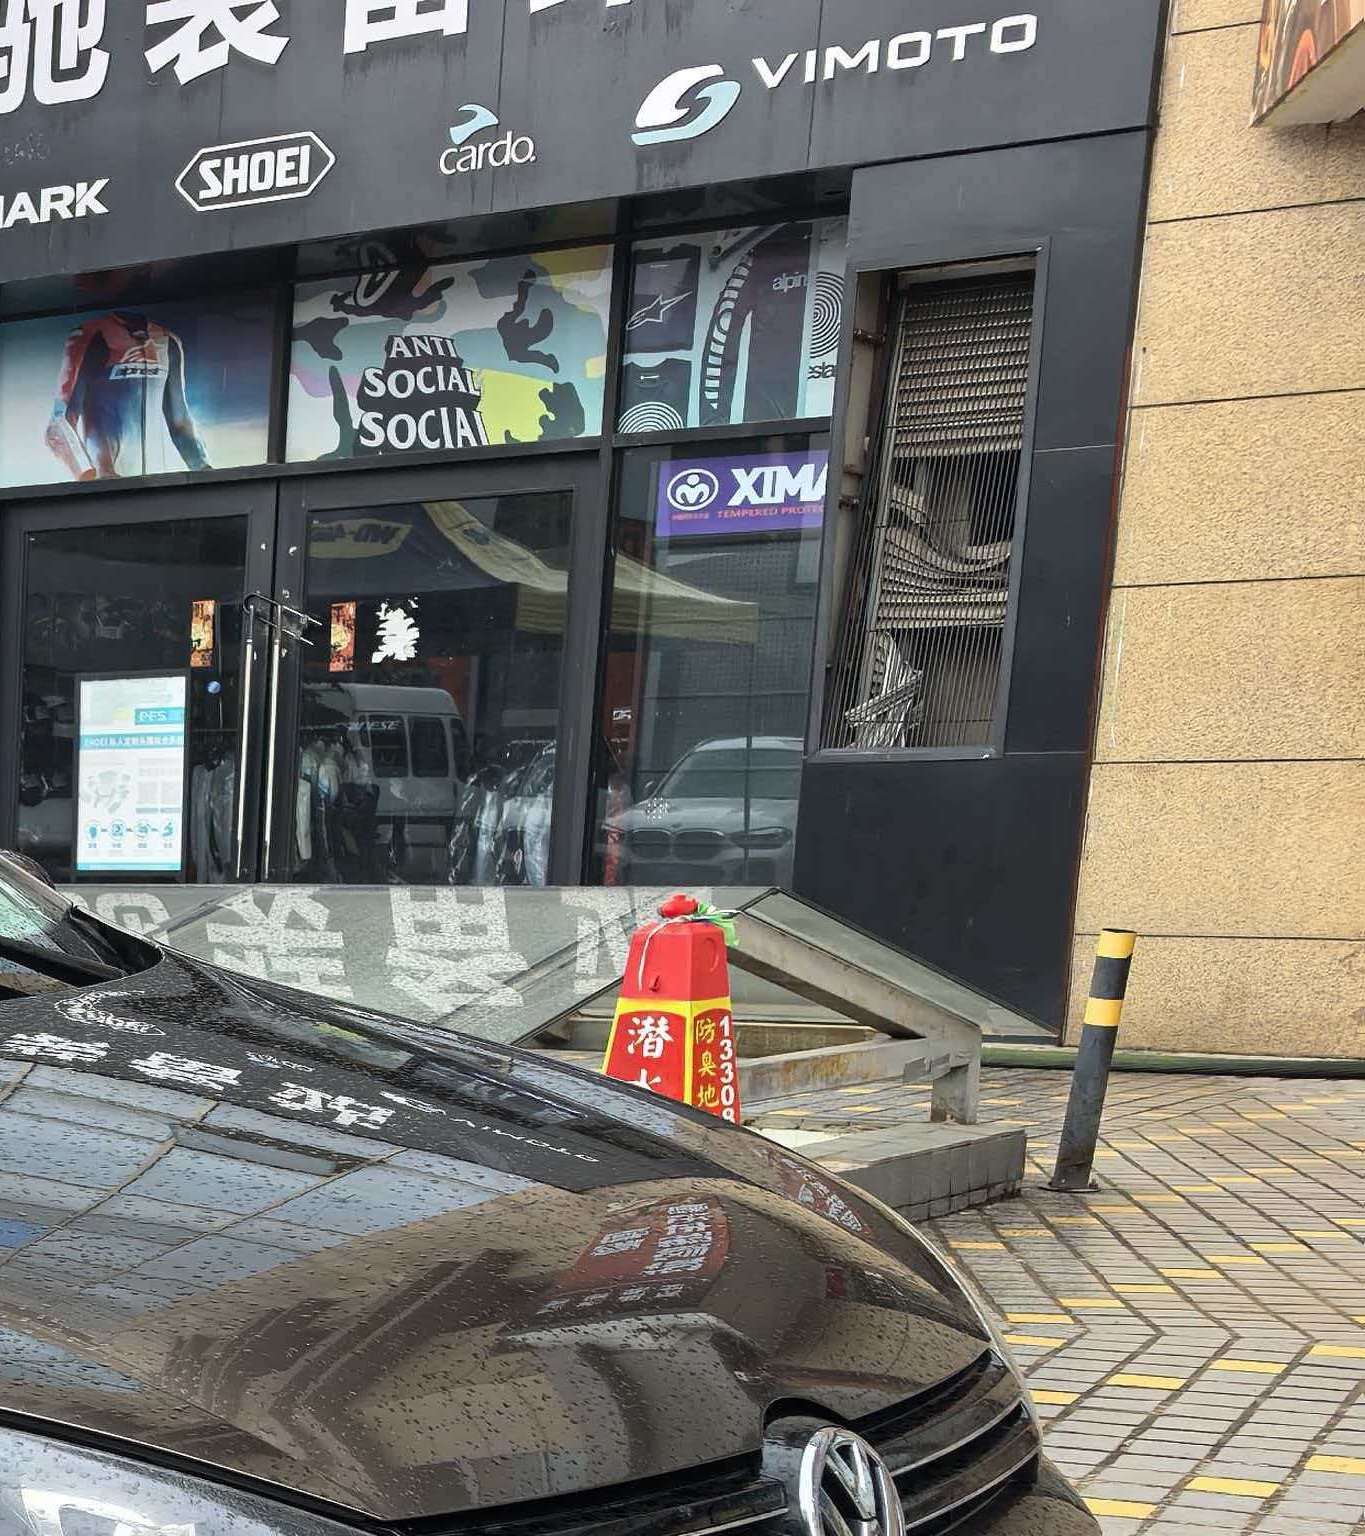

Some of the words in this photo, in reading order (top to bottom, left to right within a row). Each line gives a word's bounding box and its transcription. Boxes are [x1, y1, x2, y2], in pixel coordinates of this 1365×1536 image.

[752, 13, 1038, 89] VIMOTO
[198, 144, 311, 201] SHOEI
[389, 335, 458, 358] ANTI
[364, 365, 481, 399] SOCIAL
[695, 1018, 719, 1108] 防臭地
